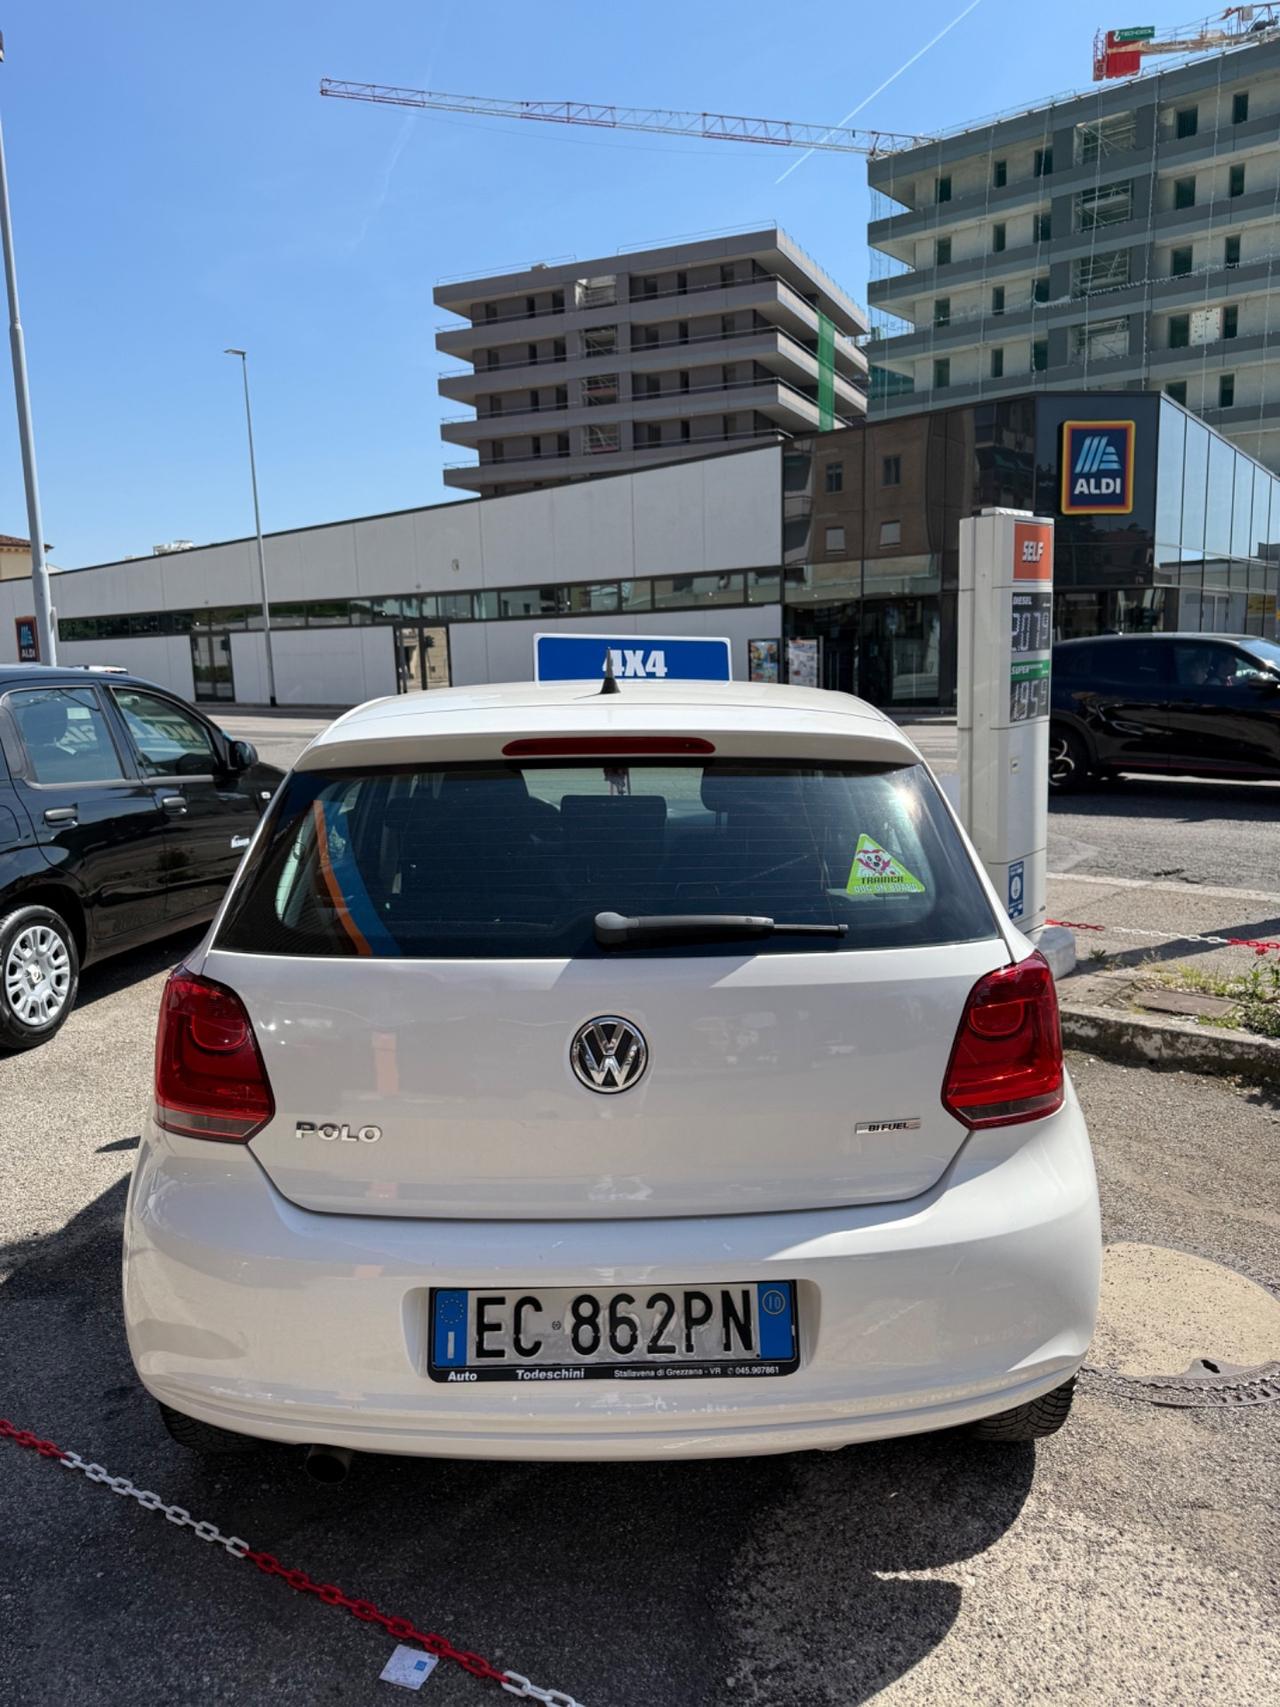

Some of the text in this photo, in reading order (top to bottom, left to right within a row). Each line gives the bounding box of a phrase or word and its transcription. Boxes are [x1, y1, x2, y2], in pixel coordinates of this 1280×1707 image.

[1073, 477, 1122, 495] ALDI
[1021, 540, 1044, 563] SELF
[1013, 595, 1033, 606] DIESEL
[1010, 664, 1030, 675] SUPER
[295, 1121, 383, 1143] POLO
[768, 1295, 782, 1310] 10
[475, 1296, 543, 1359] EC
[571, 1289, 754, 1356] 862PN
[447, 1368, 585, 1382] Auto Todeschini
[656, 1368, 665, 1377] di
[666, 1367, 704, 1377] Grezzana
[709, 1367, 722, 1375] VR
